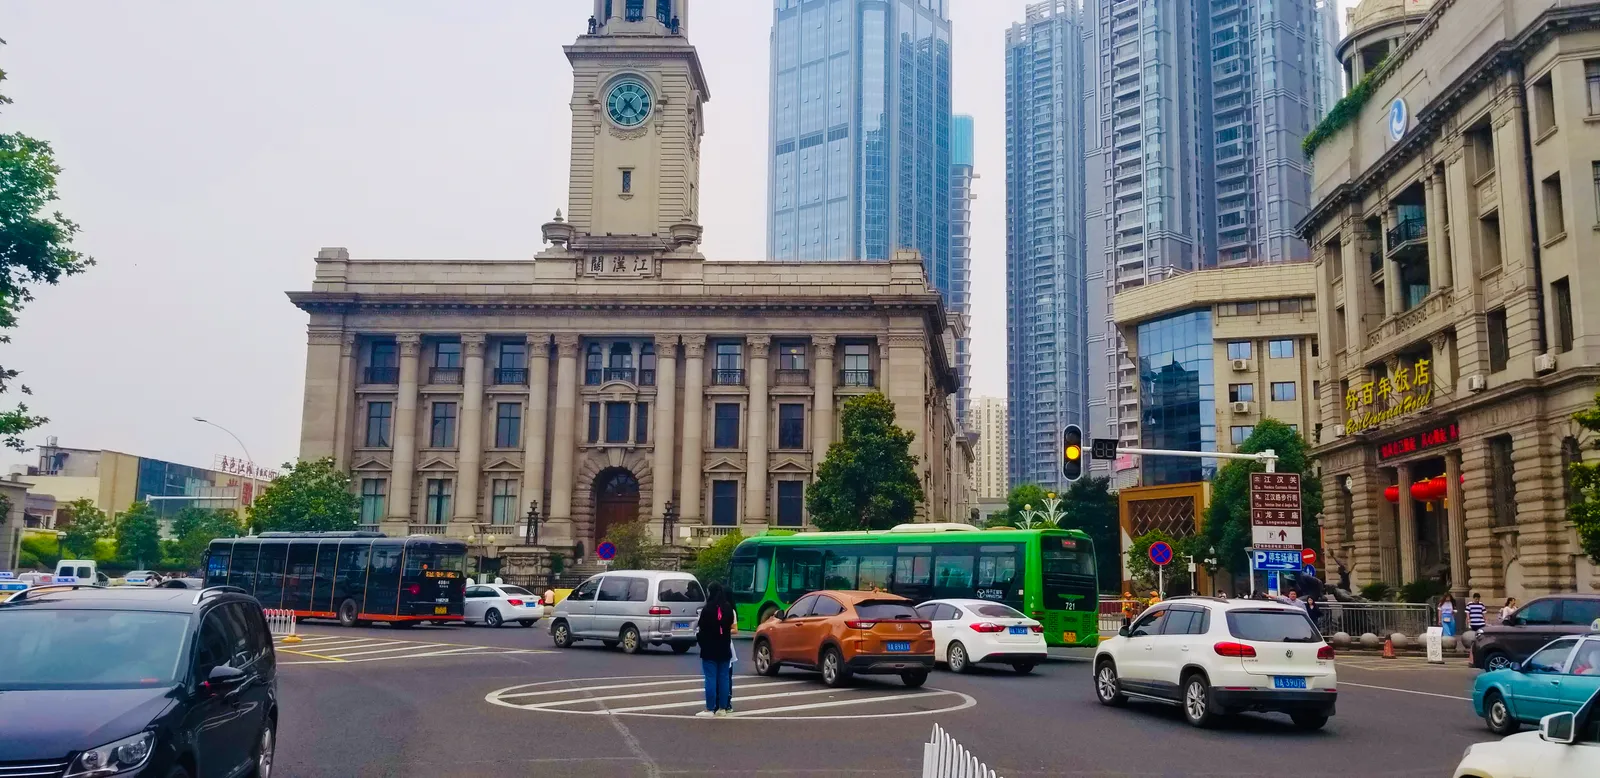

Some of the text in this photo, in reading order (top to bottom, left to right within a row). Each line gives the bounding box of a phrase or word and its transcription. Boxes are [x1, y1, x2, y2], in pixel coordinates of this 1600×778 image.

[1264, 475, 1297, 484] 江汉关
[1255, 551, 1267, 569] P
[1065, 602, 1075, 610] 721
